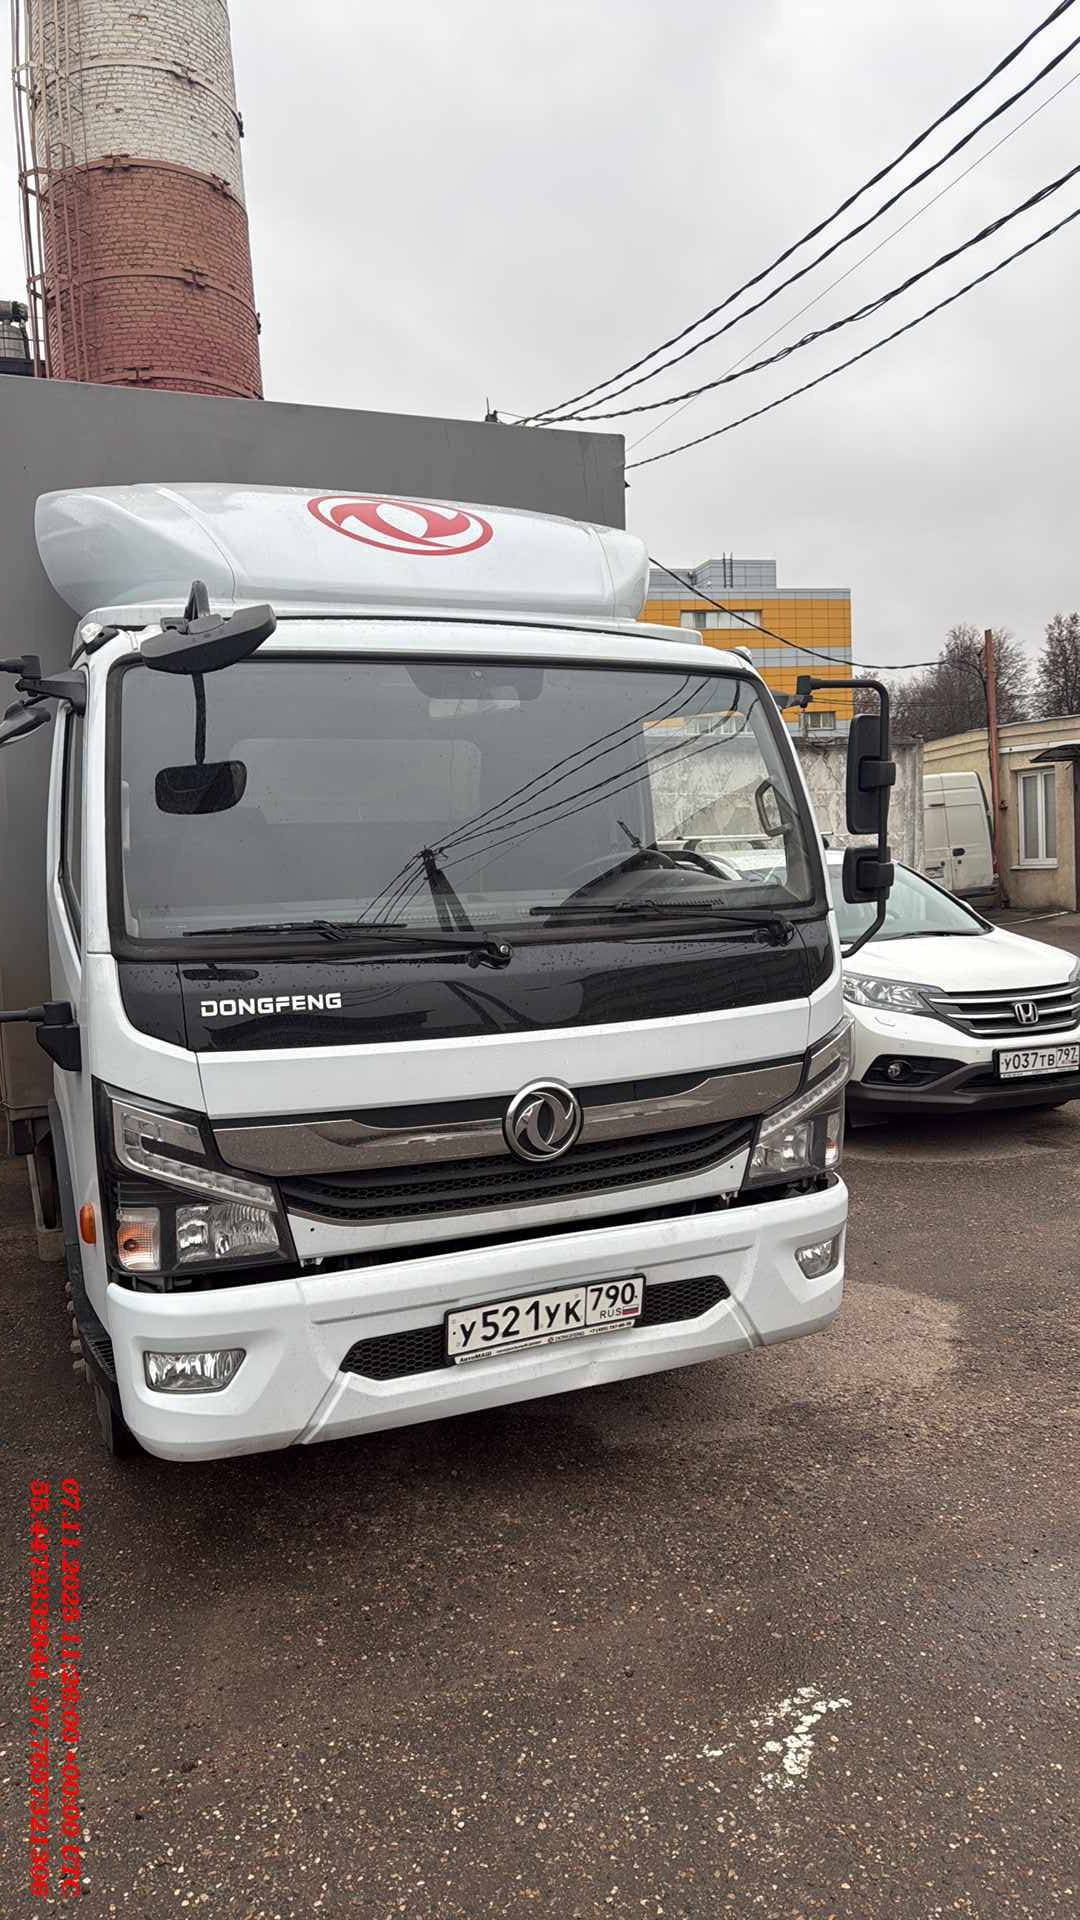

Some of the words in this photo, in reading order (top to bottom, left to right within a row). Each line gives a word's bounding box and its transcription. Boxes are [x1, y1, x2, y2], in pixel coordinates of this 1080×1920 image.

[200, 992, 342, 1017] DONGFENG
[1057, 1047, 1076, 1061] 797
[460, 1300, 581, 1347] У521УК
[590, 1283, 636, 1311] 790
[600, 1308, 622, 1319] RUS
